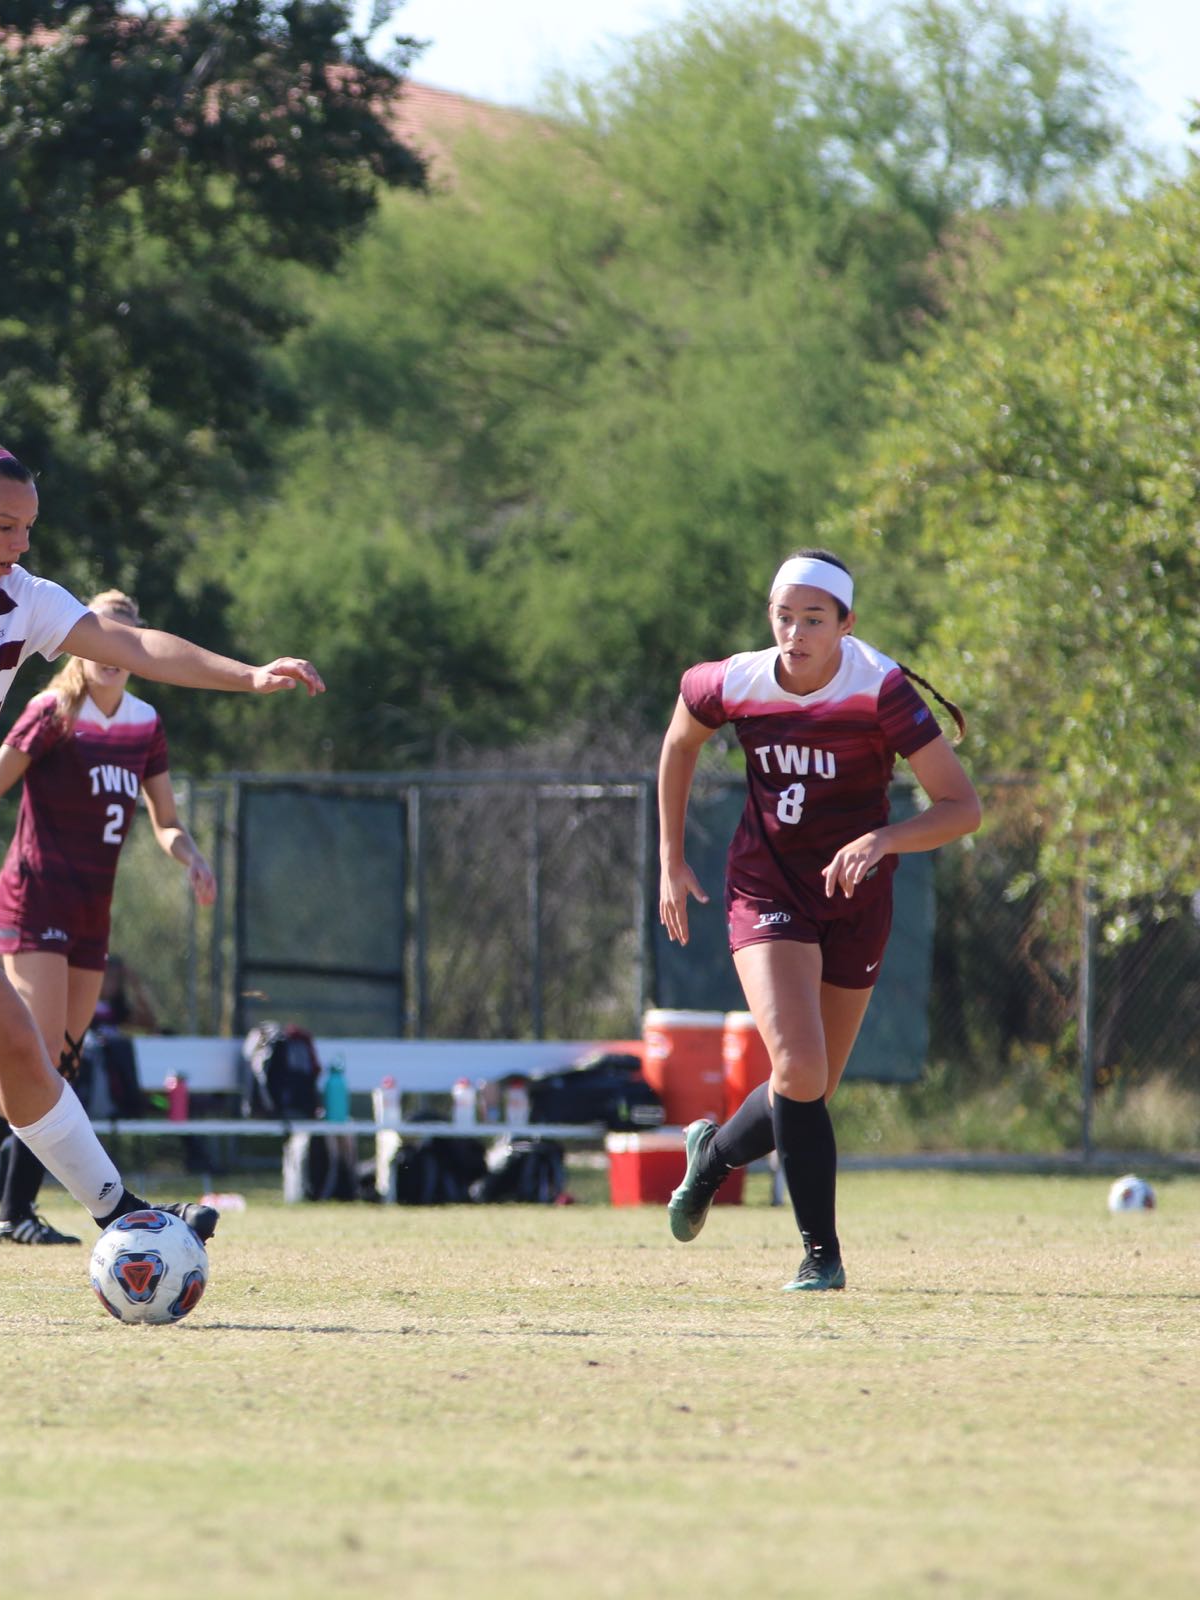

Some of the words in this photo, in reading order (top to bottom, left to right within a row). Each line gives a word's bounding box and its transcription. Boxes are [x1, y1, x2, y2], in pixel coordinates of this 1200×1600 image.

[754, 744, 836, 779] TWU
[88, 764, 138, 800] TWU
[776, 782, 806, 825] 8
[103, 803, 124, 845] 2
